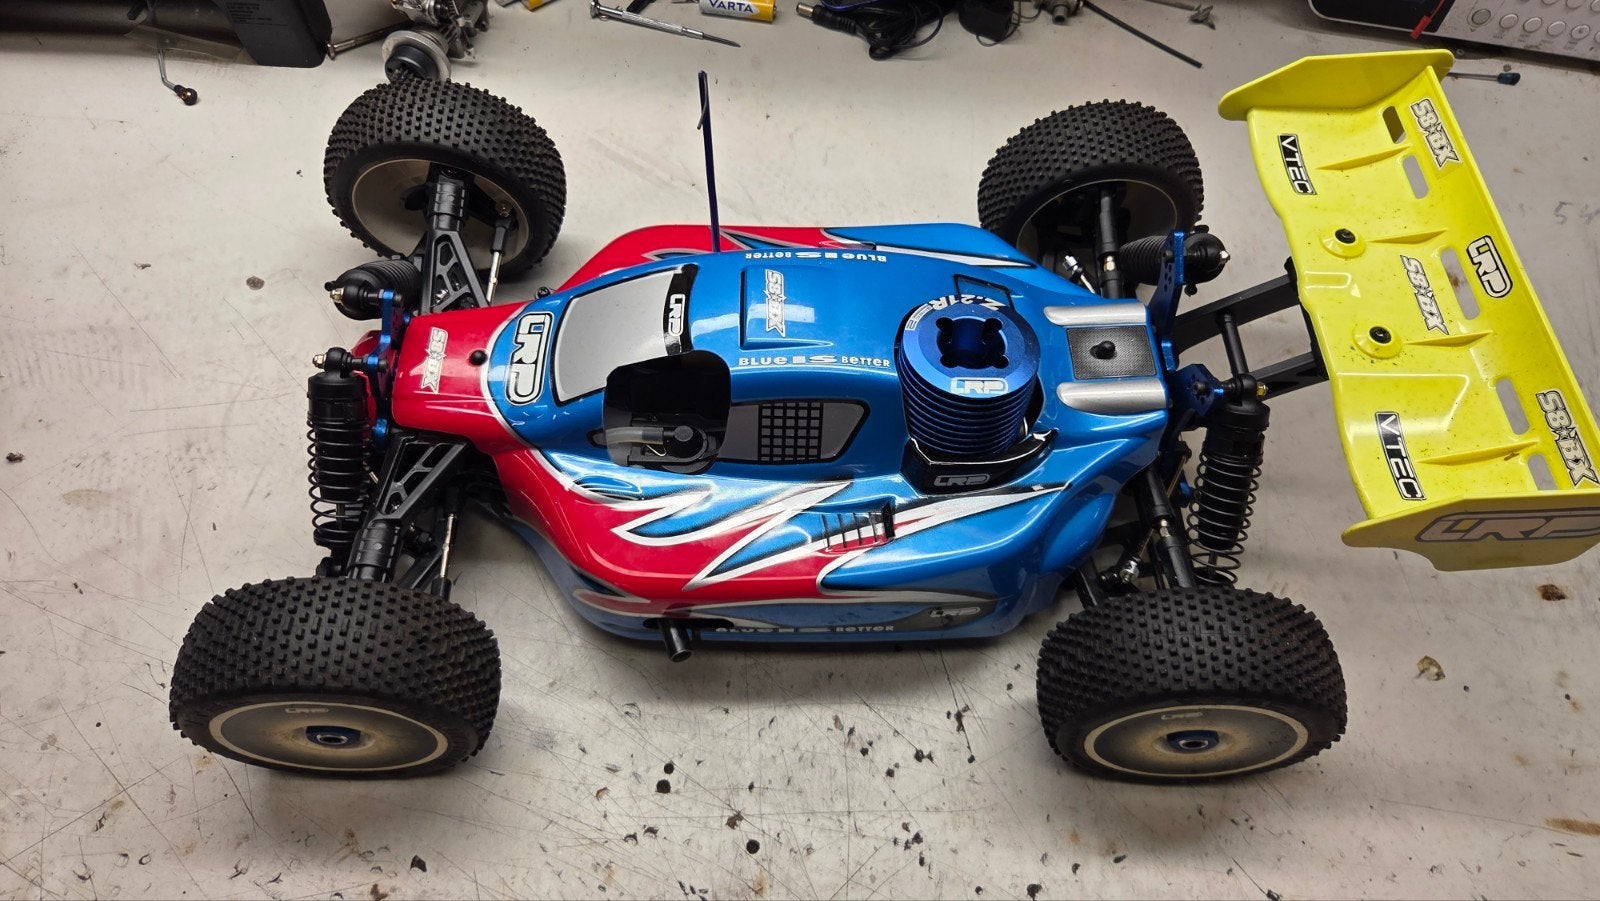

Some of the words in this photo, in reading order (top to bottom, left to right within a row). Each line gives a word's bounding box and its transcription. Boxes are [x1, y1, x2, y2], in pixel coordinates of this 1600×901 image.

[708, 0, 753, 13] VARTA
[1281, 136, 1313, 193] VTEC
[1466, 235, 1513, 298] LRP
[668, 293, 686, 337] LRP
[928, 293, 1007, 311] Z.21R
[506, 312, 554, 405] LRP
[950, 377, 1009, 395] LRP
[1380, 414, 1423, 498] VTEC
[933, 473, 991, 487] LRP
[1415, 507, 1600, 542] LRP
